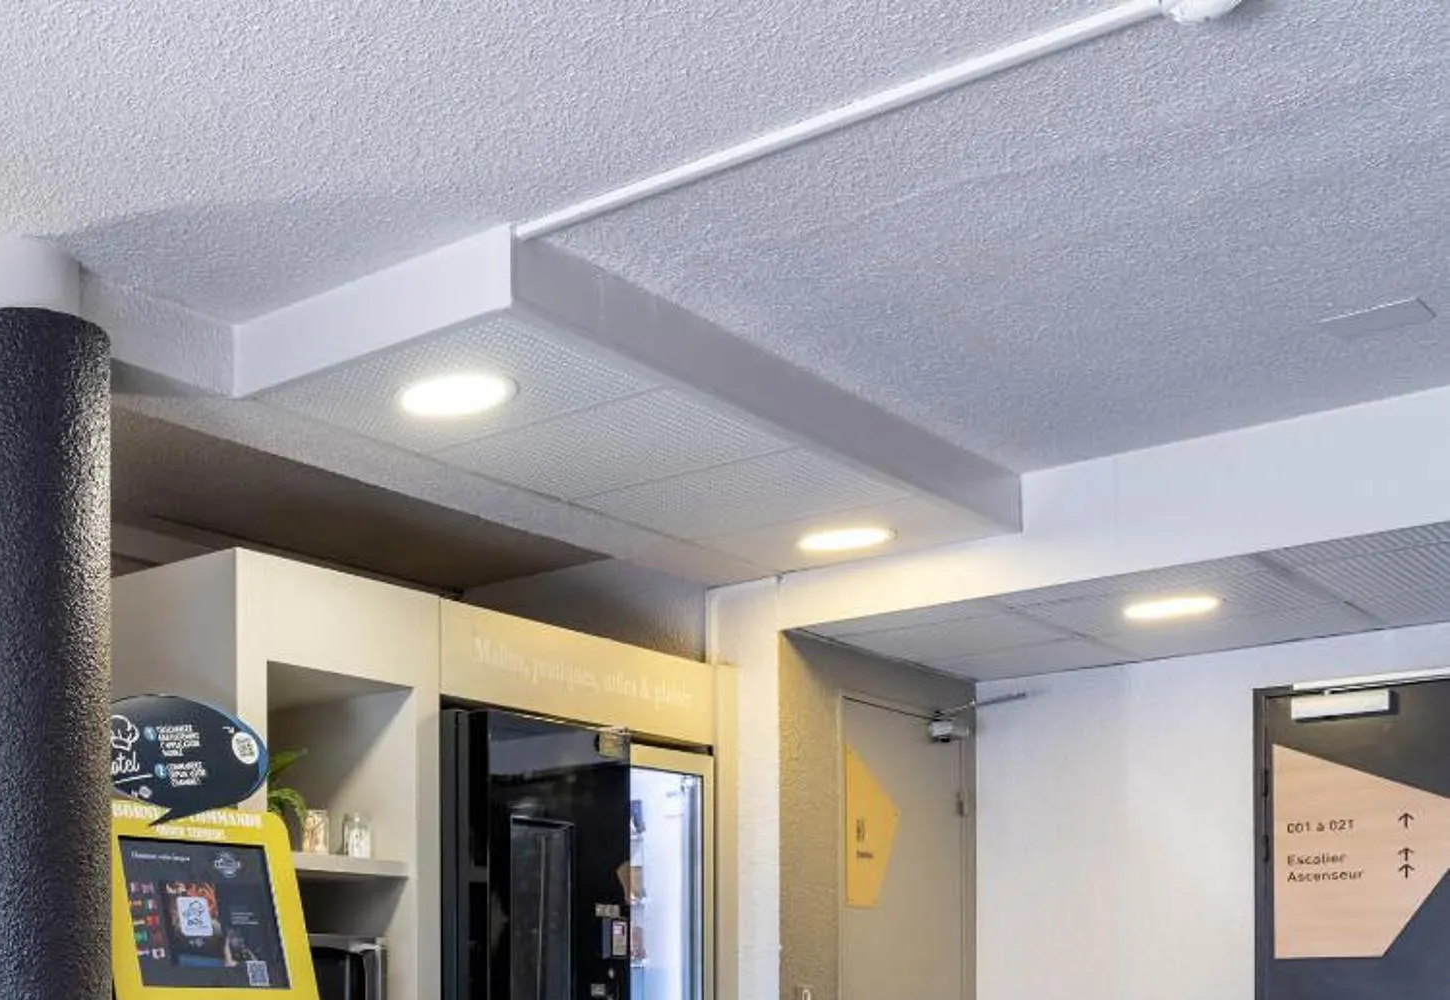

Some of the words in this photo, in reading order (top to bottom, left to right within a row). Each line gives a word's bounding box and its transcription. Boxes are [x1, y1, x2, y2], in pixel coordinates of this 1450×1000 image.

[110, 751, 140, 776] otel
[1286, 821, 1310, 834] 001
[1329, 818, 1354, 832] 021
[1287, 851, 1348, 865] Escalier
[1286, 869, 1365, 883] Ascenseur
